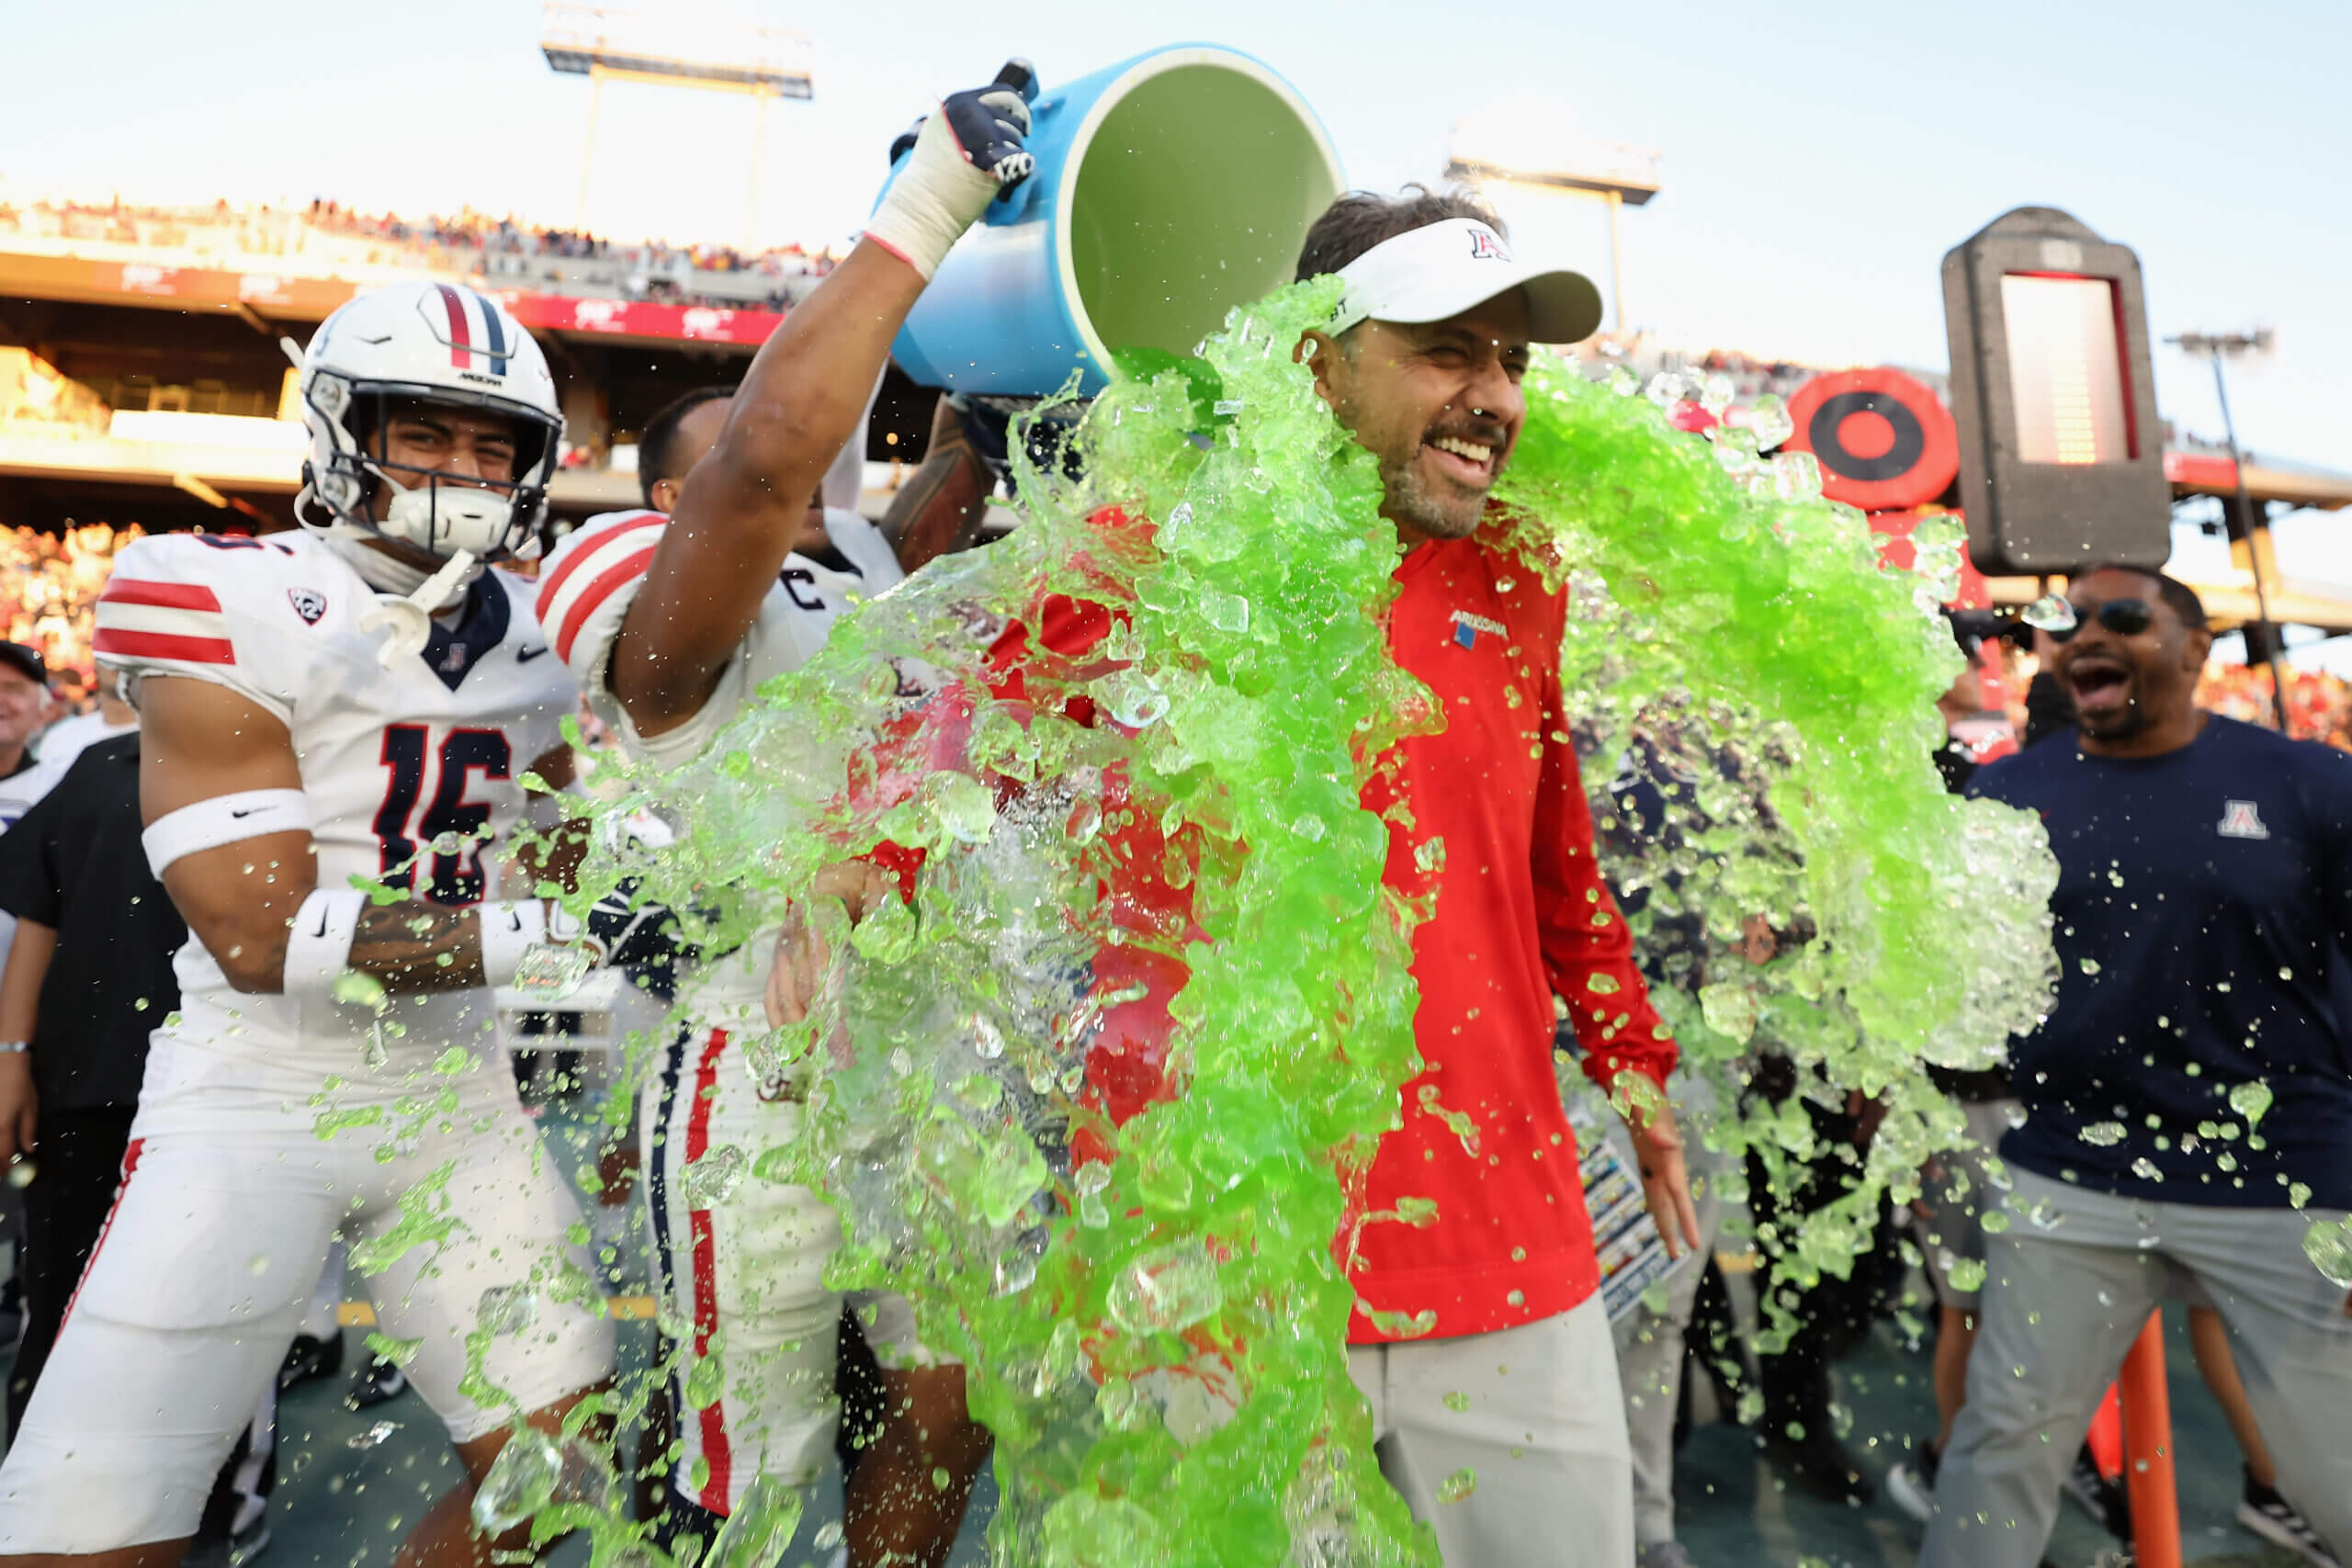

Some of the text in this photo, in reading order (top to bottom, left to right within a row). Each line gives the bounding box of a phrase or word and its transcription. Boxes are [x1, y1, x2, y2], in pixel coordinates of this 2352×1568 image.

[1467, 229, 1511, 262] A
[779, 569, 826, 611] C
[372, 722, 512, 908] 16
[2217, 798, 2271, 840] A
